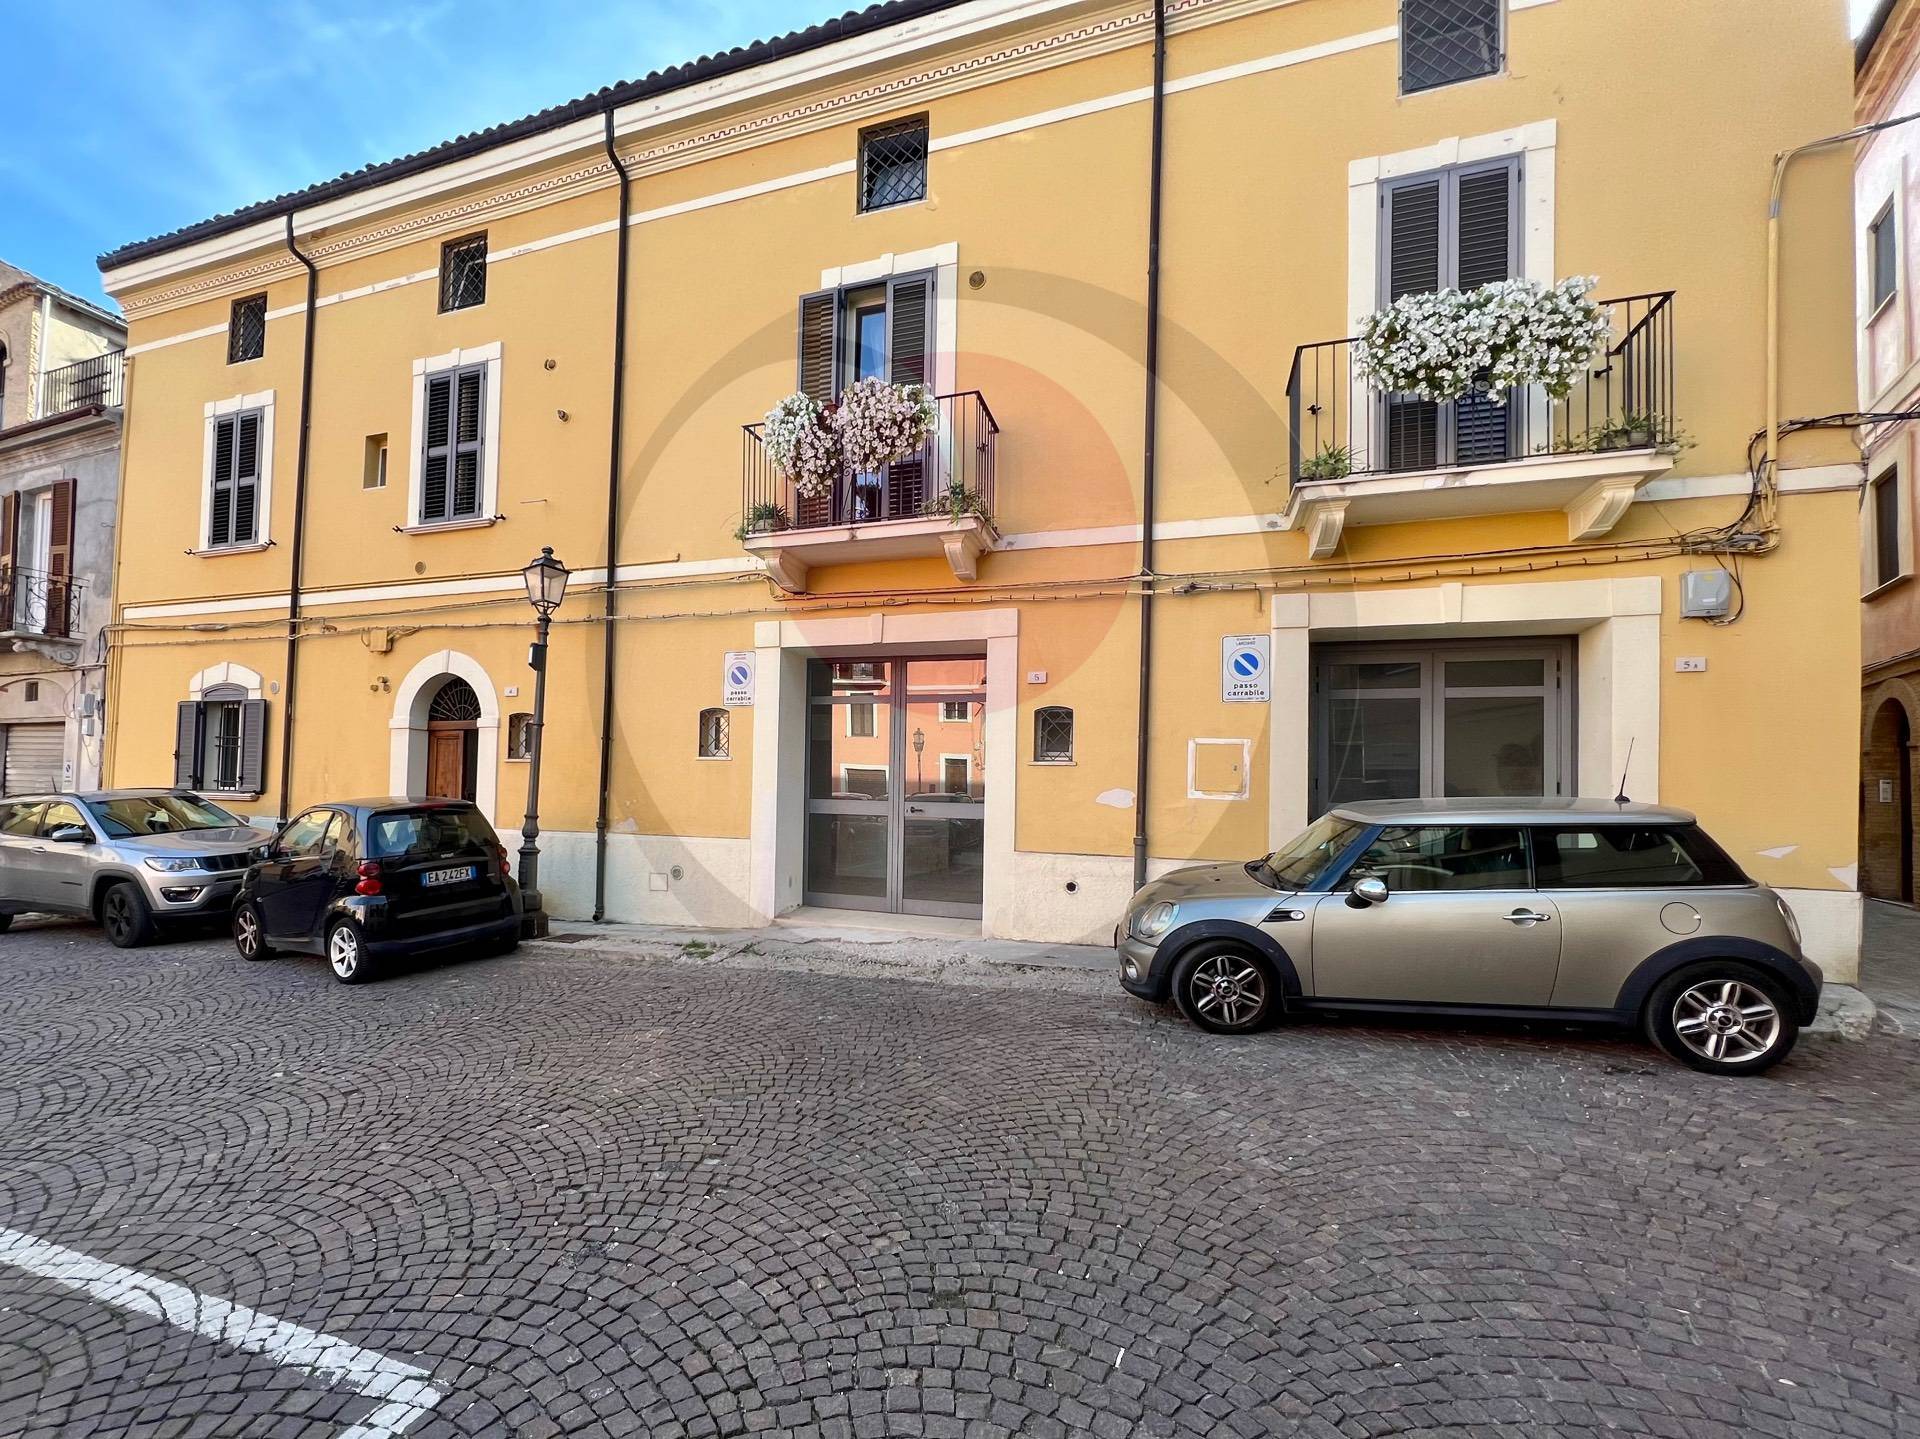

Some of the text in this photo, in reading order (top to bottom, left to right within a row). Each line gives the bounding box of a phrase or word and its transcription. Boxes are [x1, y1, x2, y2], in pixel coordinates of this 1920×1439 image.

[1683, 660, 1690, 669] 5
[1034, 673, 1040, 681] 5
[428, 867, 471, 883] EA 242FX
